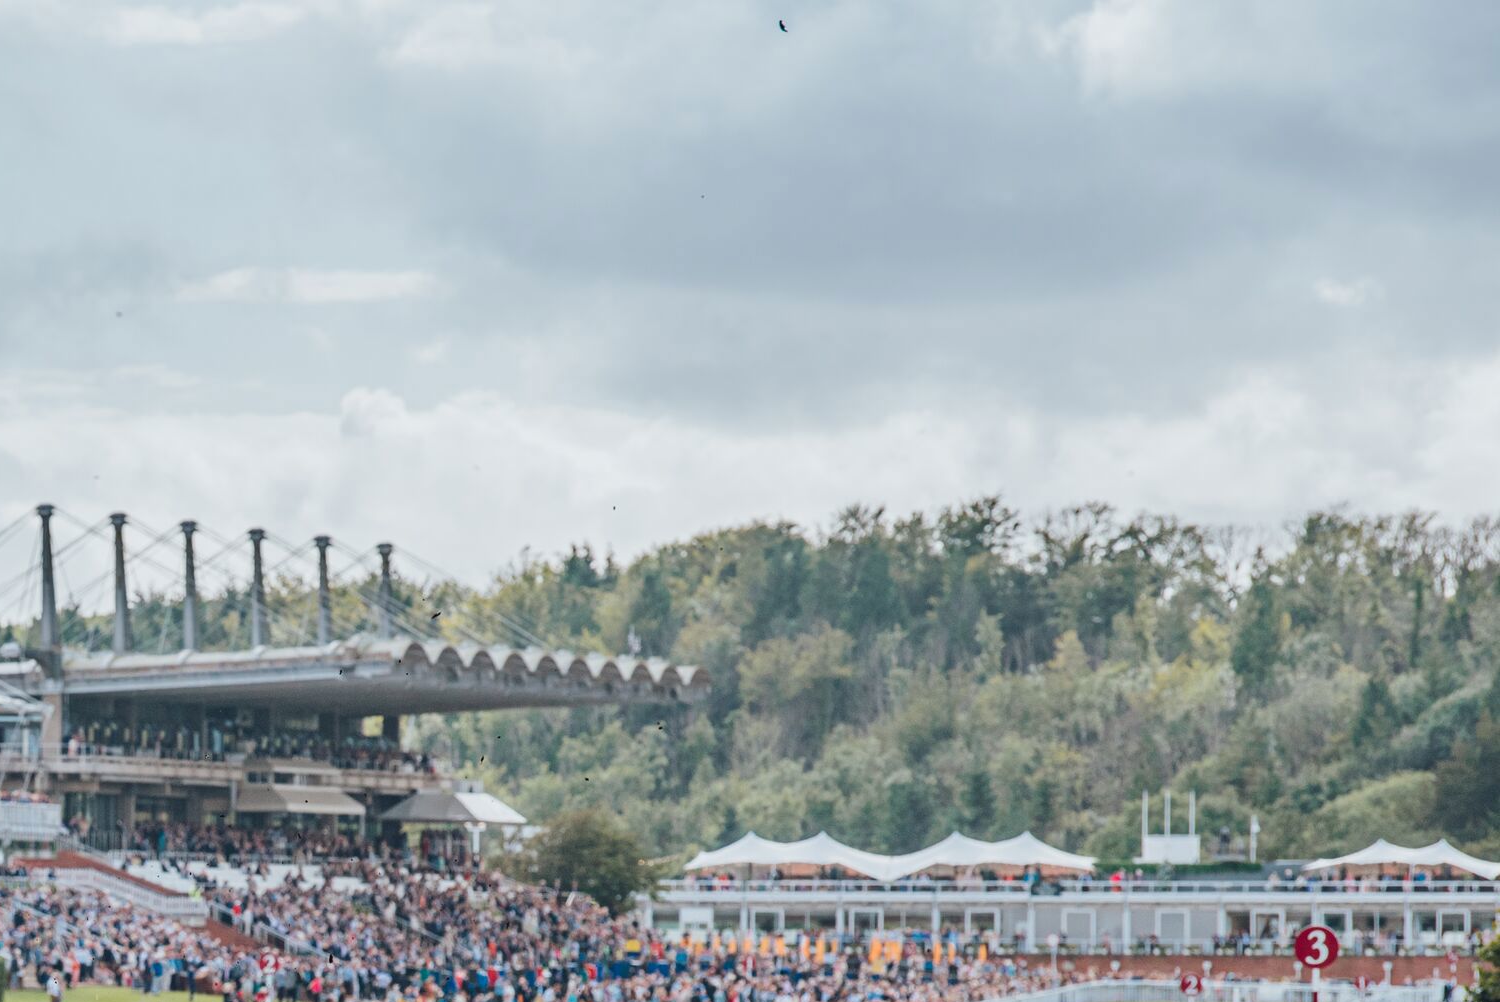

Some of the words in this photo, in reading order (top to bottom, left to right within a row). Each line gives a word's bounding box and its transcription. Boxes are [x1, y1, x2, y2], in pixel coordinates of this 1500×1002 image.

[1305, 930, 1329, 965] 3
[263, 953, 276, 973] 2
[1185, 975, 1198, 995] 2
